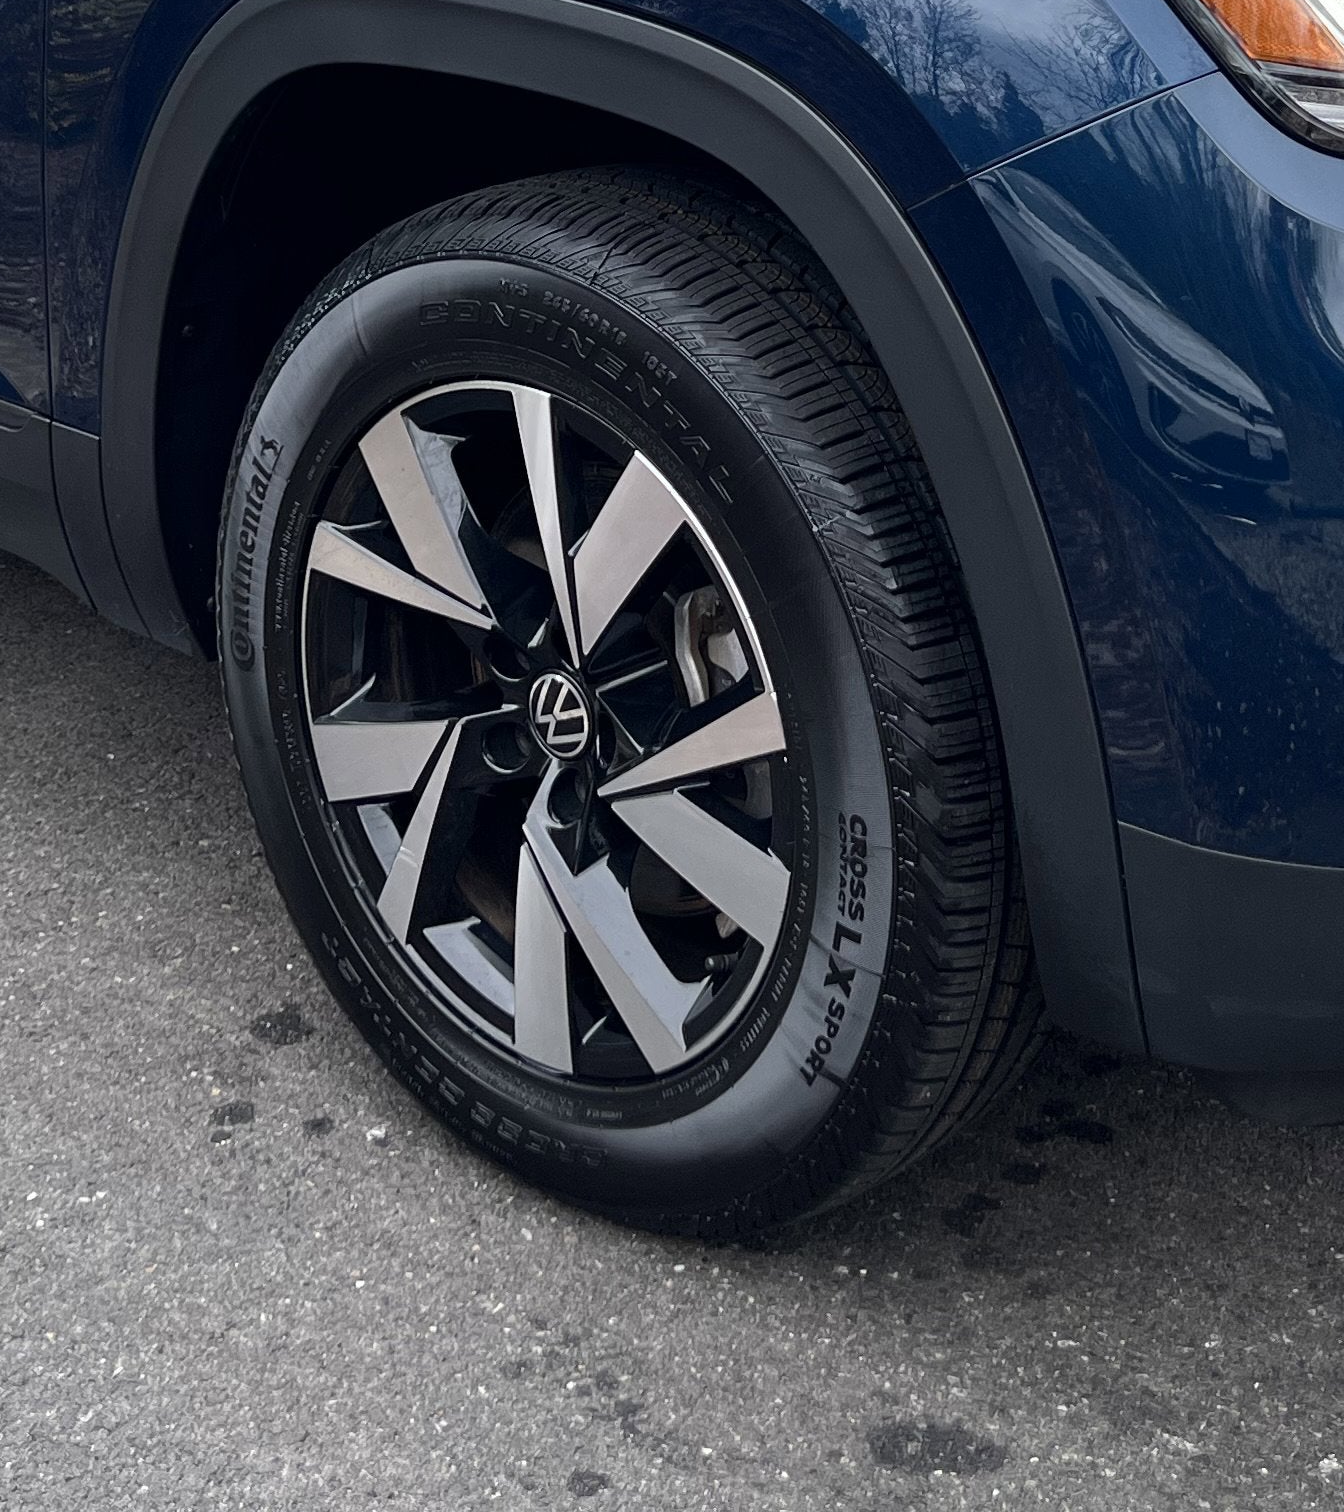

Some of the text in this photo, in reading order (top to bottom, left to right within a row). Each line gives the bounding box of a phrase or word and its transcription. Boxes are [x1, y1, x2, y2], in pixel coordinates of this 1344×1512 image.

[230, 453, 275, 672] Continental
[837, 810, 850, 917] CONTACT
[848, 812, 869, 923] CROSS
[799, 995, 845, 1087] SPORT
